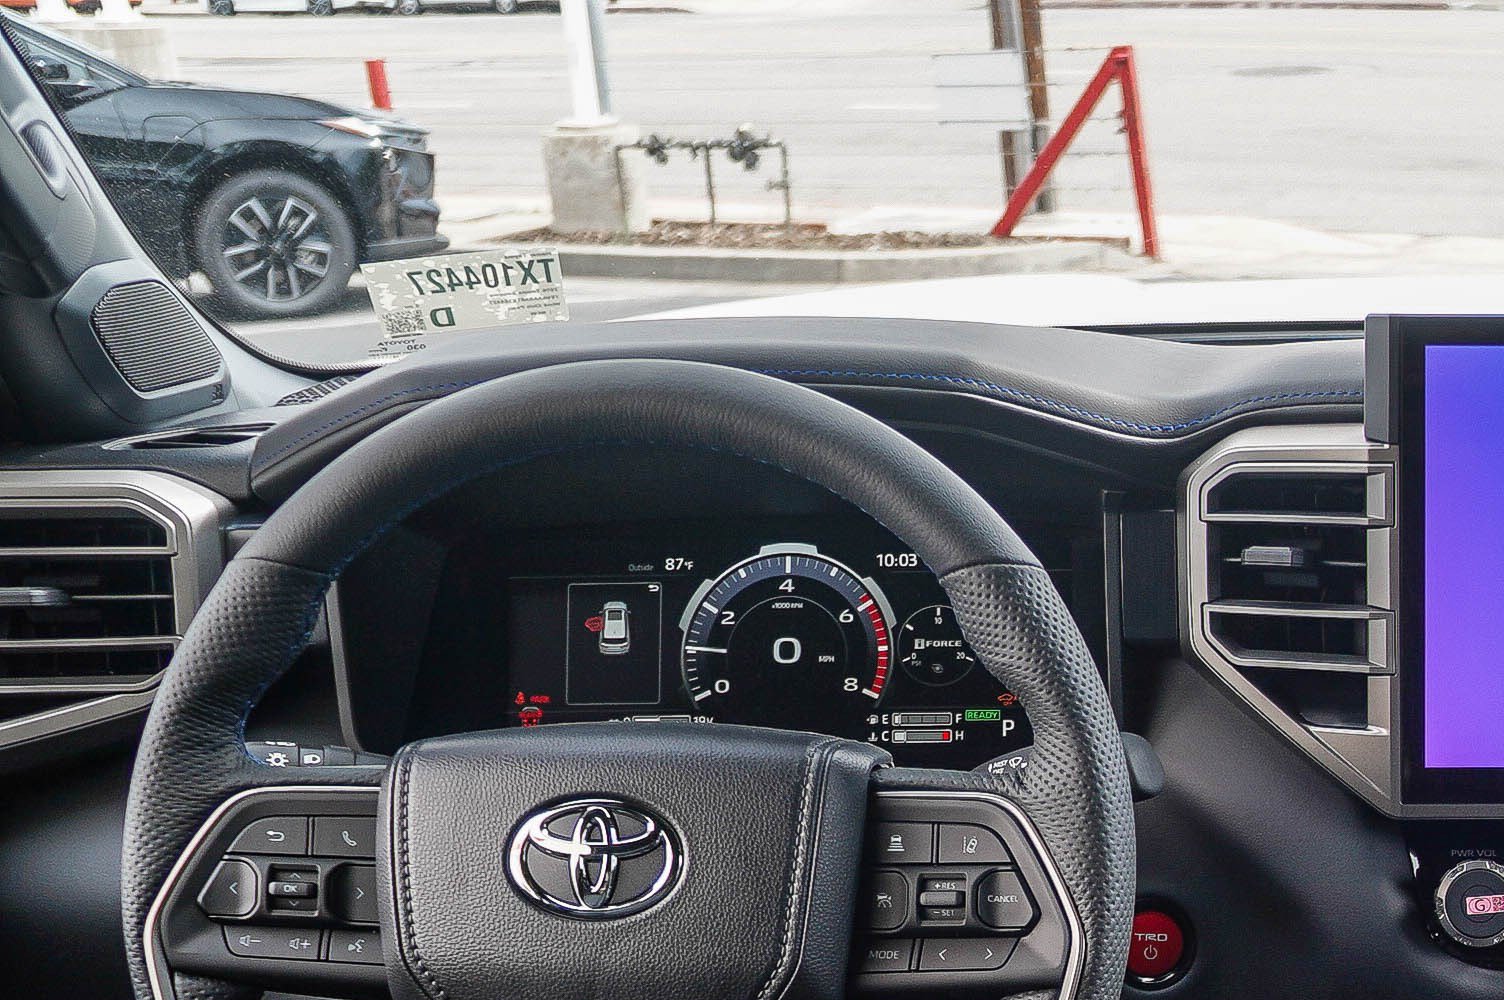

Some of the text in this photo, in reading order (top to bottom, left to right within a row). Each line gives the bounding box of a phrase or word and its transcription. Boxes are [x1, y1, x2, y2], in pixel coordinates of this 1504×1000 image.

[875, 554, 918, 568] 10:03
[778, 578, 795, 592] 4
[720, 611, 735, 624] 2
[839, 609, 854, 623] 6
[934, 617, 943, 625] 10
[773, 637, 801, 663] 0
[818, 655, 834, 663] MPH
[911, 652, 917, 660] 0
[956, 651, 966, 660] 20
[714, 679, 730, 694] 0
[843, 677, 858, 691] 8
[881, 713, 962, 724] E F
[967, 711, 998, 719] READY
[1002, 719, 1015, 737] P
[881, 730, 964, 741] C H
[1451, 849, 1497, 857] PWR VOL
[283, 884, 298, 893] OK
[988, 895, 1019, 903] CANCEL
[1134, 933, 1168, 942] TRD
[868, 950, 900, 959] MODE
